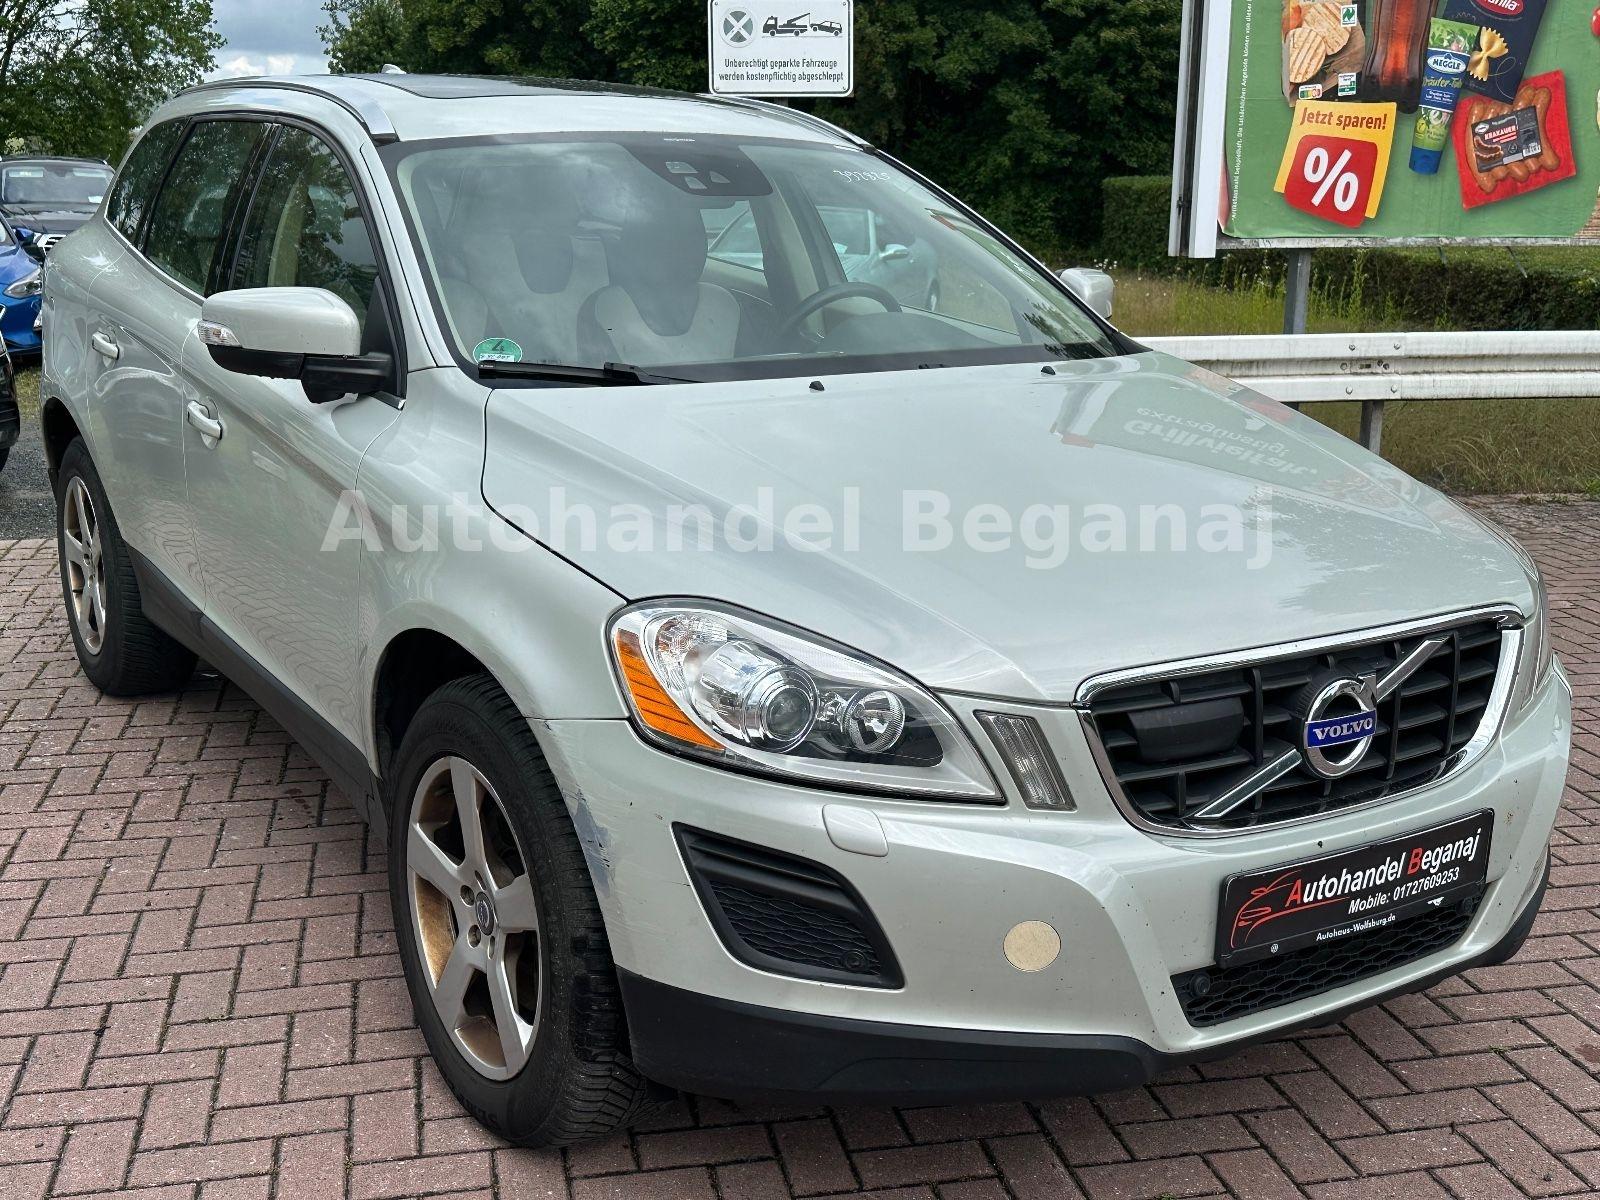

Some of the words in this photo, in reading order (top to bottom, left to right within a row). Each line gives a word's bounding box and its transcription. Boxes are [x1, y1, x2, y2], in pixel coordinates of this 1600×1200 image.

[724, 58, 769, 70] Unberechtigt
[770, 58, 801, 70] geparkte
[801, 58, 838, 70] Fahrzeuge
[1432, 58, 1462, 71] MEGGLE
[718, 71, 745, 81] werden
[746, 71, 797, 83] kostenpflichtig
[798, 71, 844, 83] abgeschleppt
[1300, 107, 1334, 126] Jetzt
[1336, 113, 1388, 130] sparen!
[1303, 147, 1359, 212] %
[491, 339, 505, 352] 4
[1313, 718, 1373, 741] VOLVO
[1285, 852, 1407, 908] Autohandel
[1407, 828, 1482, 875] Beganaj
[1348, 894, 1391, 915] Mobile:
[1392, 867, 1461, 901] 01727609253
[1316, 913, 1397, 942] Autohaus-Wolfsburg.de
